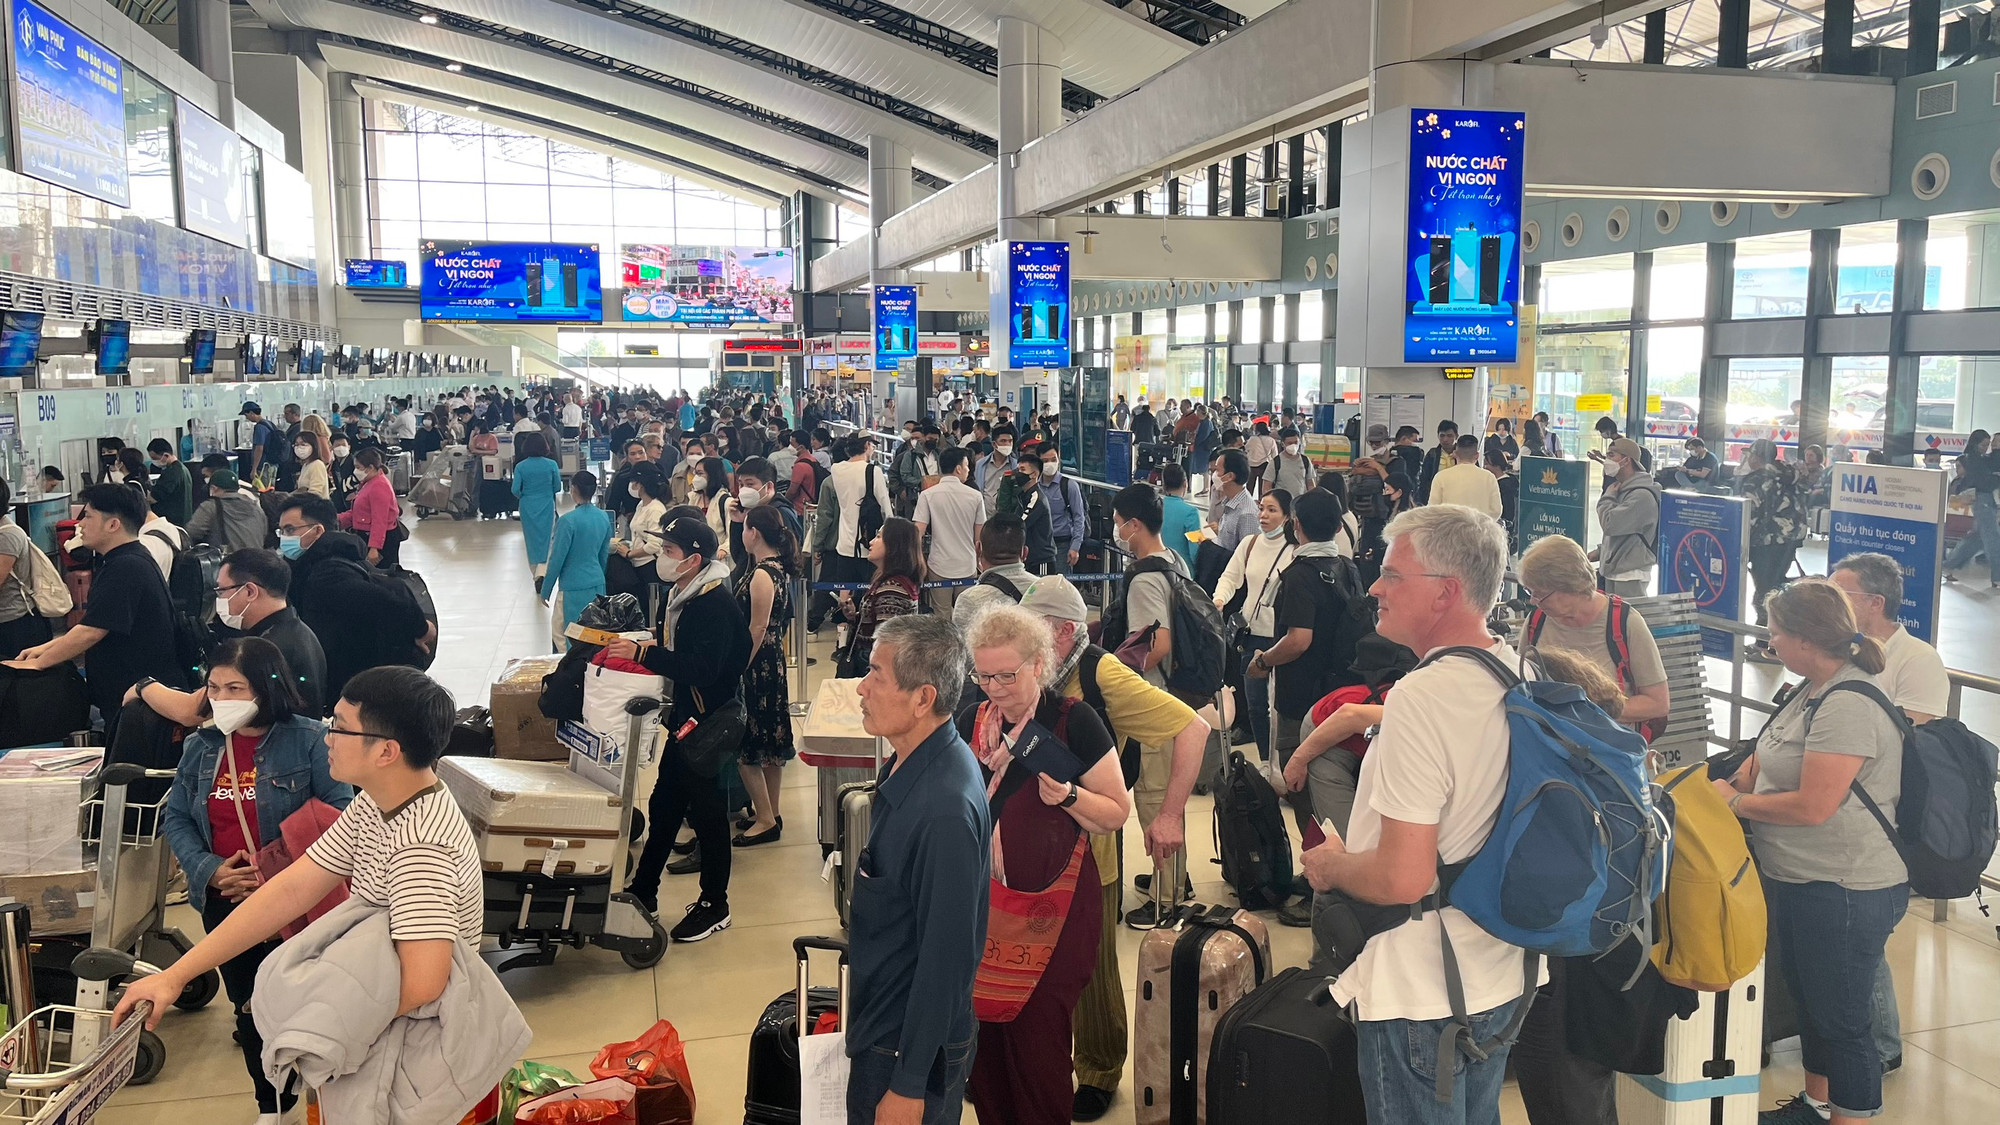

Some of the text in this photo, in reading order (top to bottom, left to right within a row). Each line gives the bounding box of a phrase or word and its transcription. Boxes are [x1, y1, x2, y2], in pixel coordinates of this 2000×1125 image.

[1426, 154, 1507, 170] NƯỚC CHẤT
[1438, 172, 1496, 188] VỊ NGON
[435, 257, 501, 268] NƯỚC CHẤT
[1018, 263, 1040, 271] NƯỚC
[446, 270, 493, 280] VỊ NGON
[1455, 324, 1490, 336] KAROFI
[841, 340, 870, 348] LUCKY
[38, 395, 56, 421] B09
[106, 392, 120, 416] B10
[135, 391, 147, 413] B11
[1529, 484, 1571, 497] Vietnam Airlines
[1841, 473, 1877, 495] NIA
[1885, 484, 1923, 493] INTERNATIONAL
[1549, 514, 1560, 523] VÀO
[1533, 523, 1544, 532] LÀM
[1860, 526, 1873, 536] thủ
[1876, 528, 1890, 539] tục
[1892, 530, 1916, 544] đóng
[1835, 535, 1904, 552] Check-in counter closes
[1023, 735, 1038, 757] Gebeco
